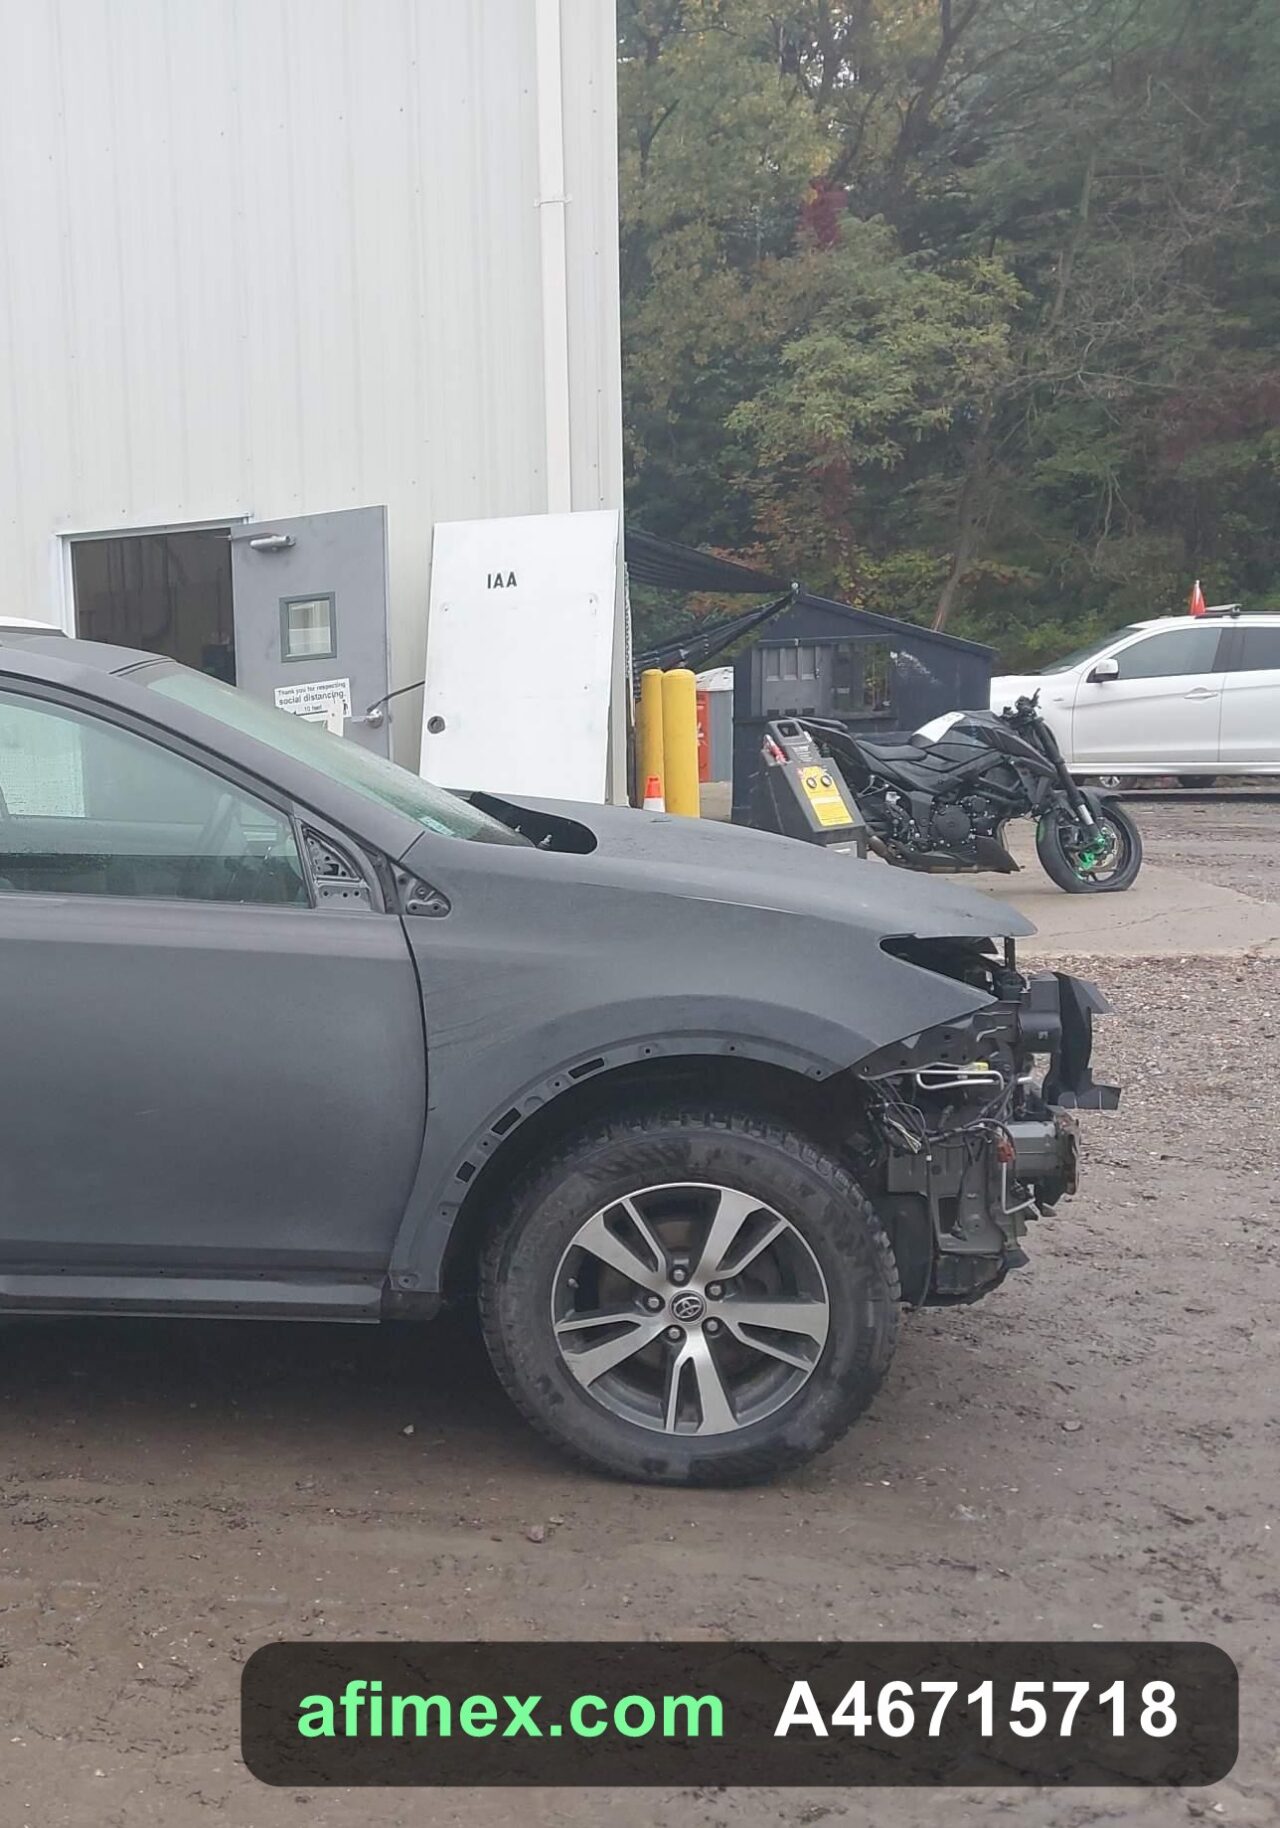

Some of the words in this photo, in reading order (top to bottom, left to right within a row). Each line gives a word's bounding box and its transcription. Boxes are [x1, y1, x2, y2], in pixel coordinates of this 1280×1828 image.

[487, 571, 518, 590] IAA
[316, 682, 346, 691] respecting
[279, 695, 302, 706] social
